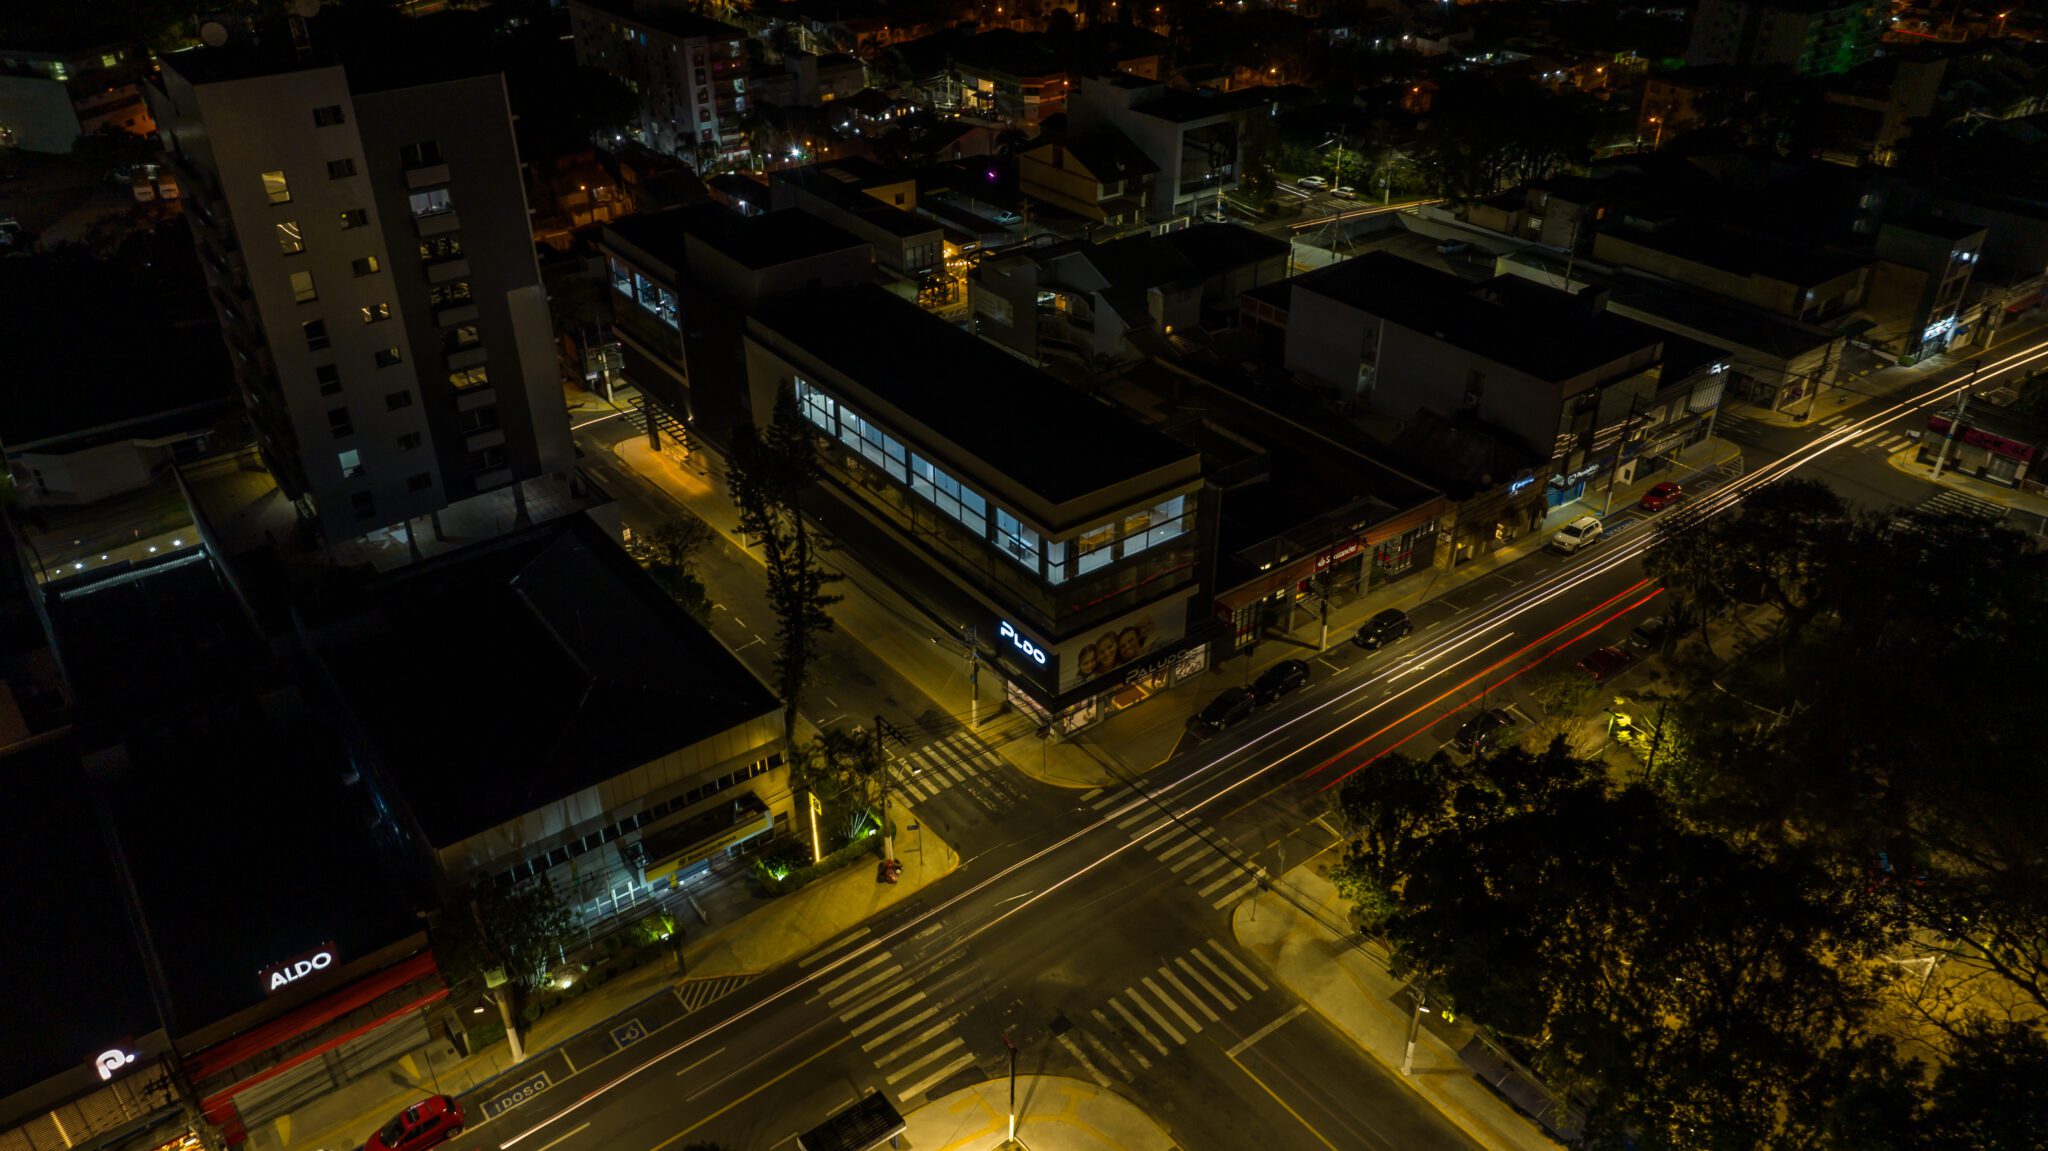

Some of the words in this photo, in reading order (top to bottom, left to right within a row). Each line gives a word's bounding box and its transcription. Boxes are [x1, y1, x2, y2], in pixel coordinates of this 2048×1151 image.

[1125, 649, 1189, 683] PALUDO
[269, 951, 332, 990] ALDO
[495, 1080, 545, 1112] IDOSO
